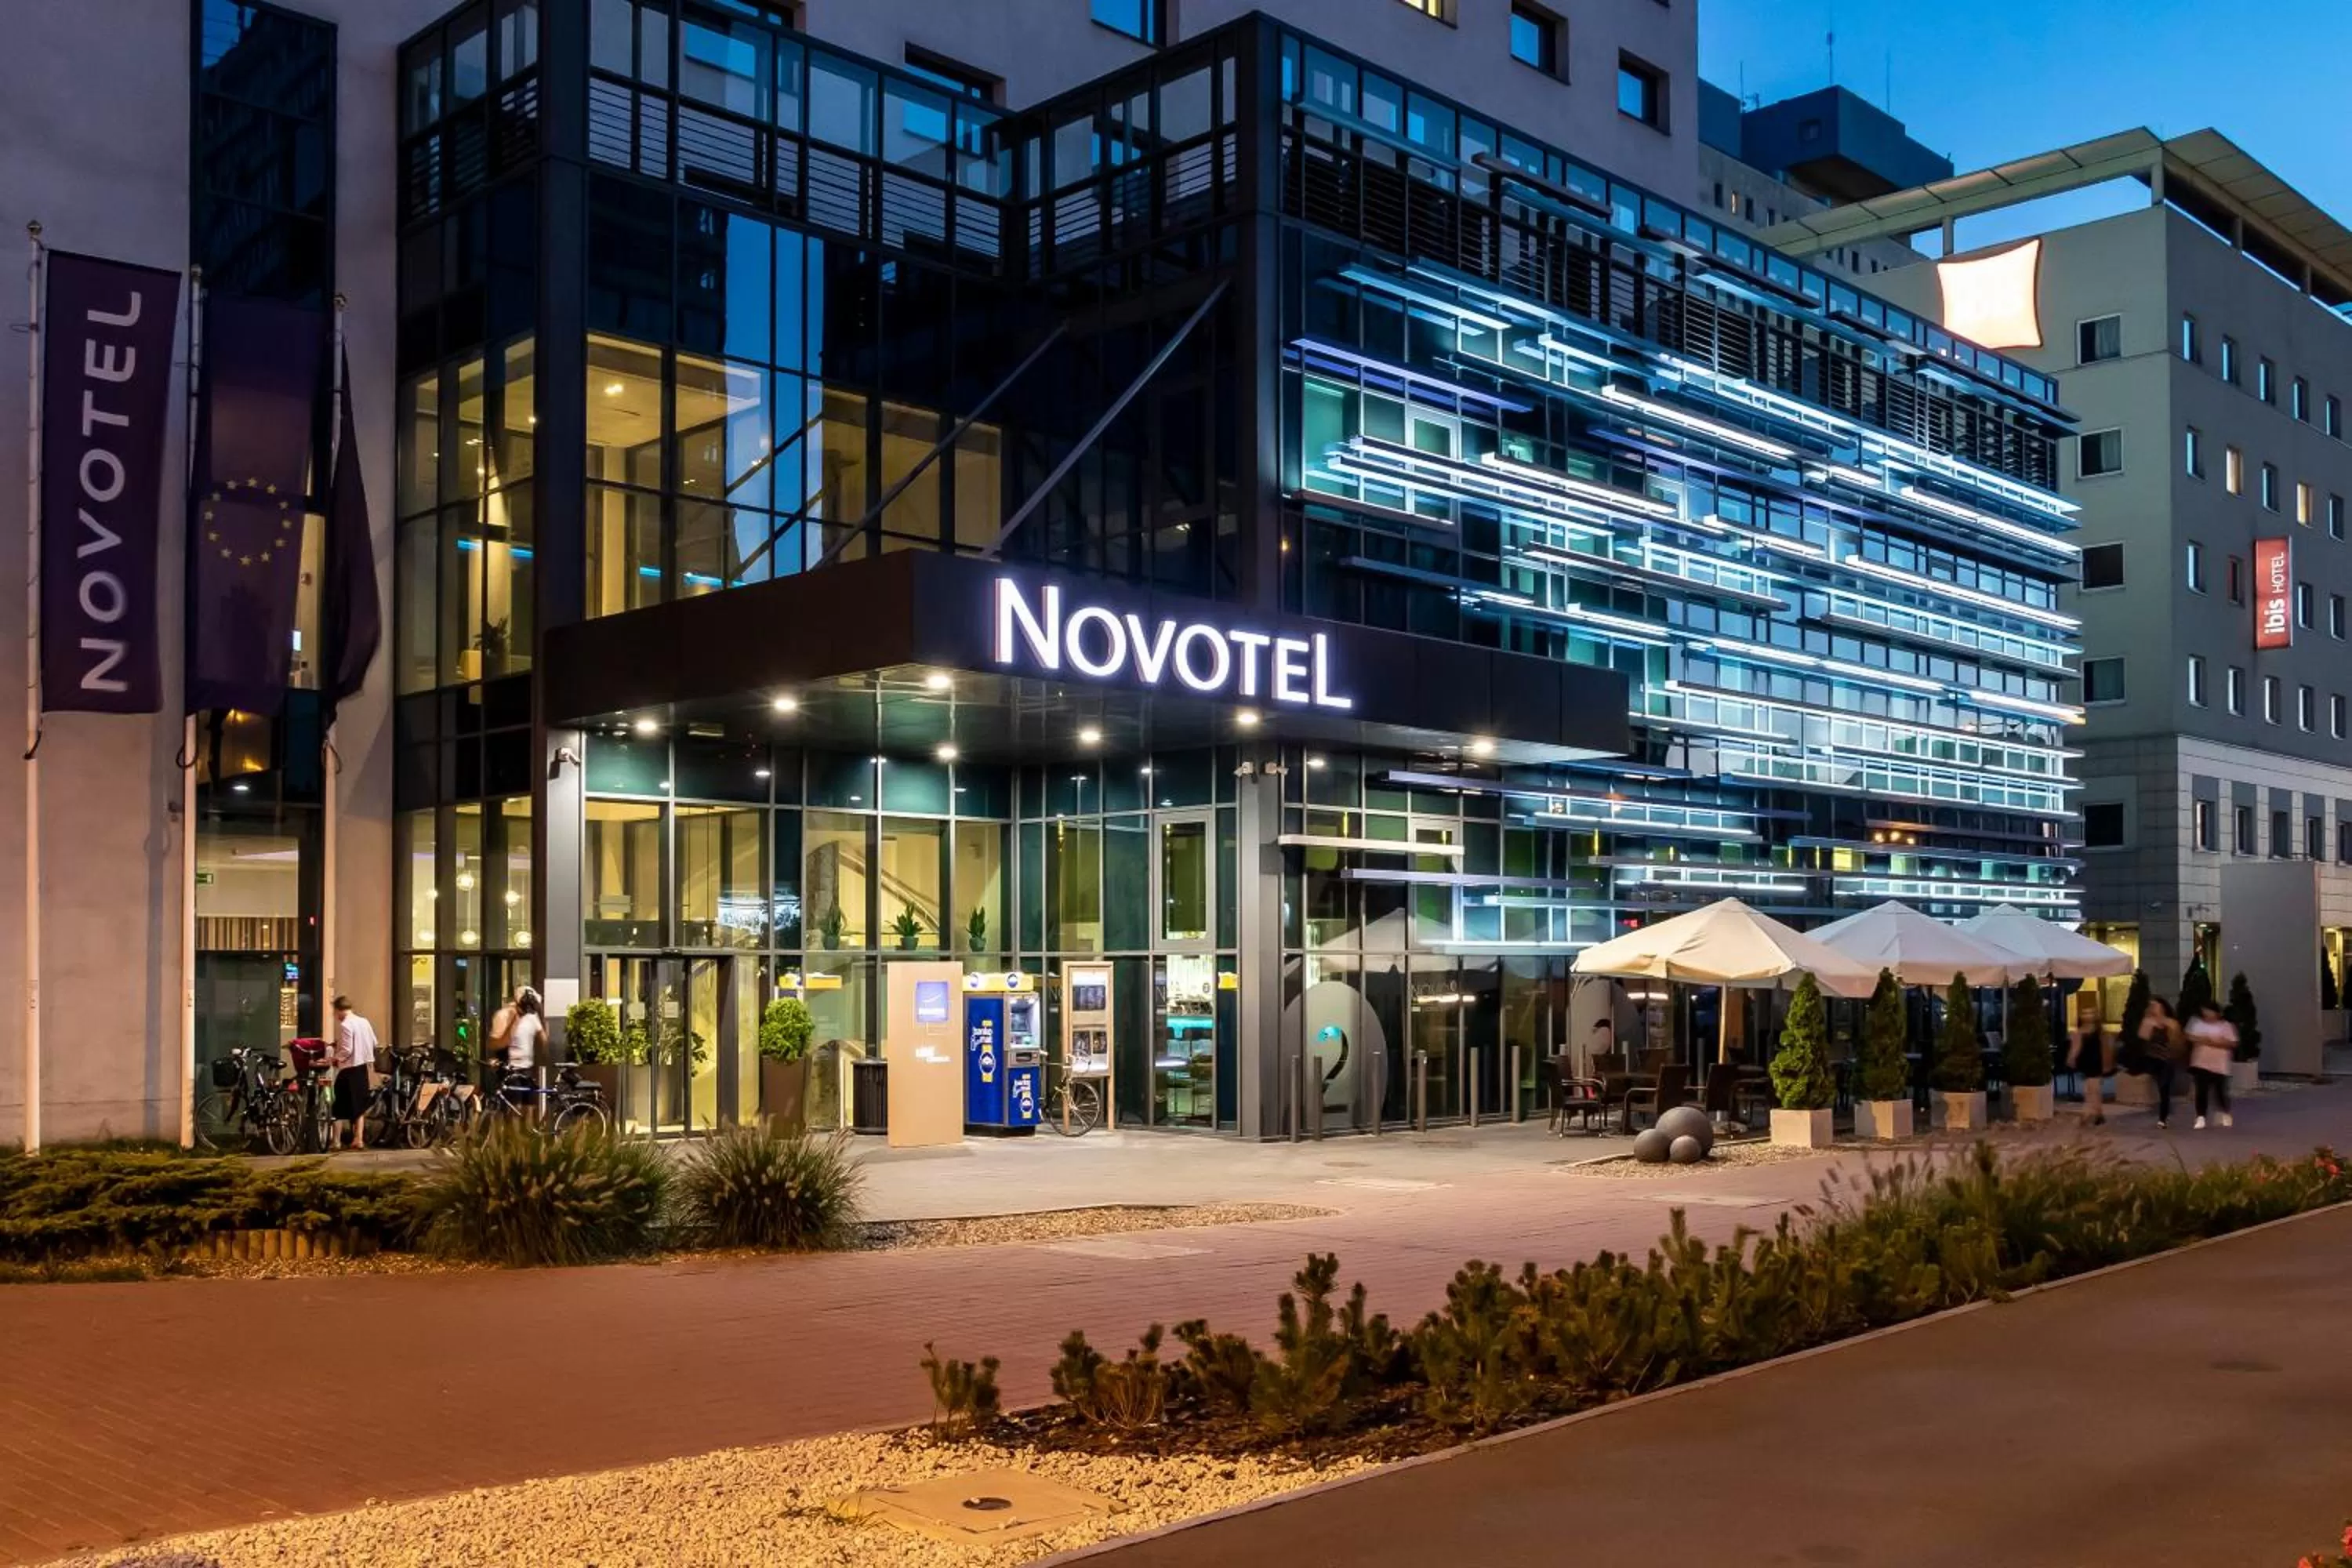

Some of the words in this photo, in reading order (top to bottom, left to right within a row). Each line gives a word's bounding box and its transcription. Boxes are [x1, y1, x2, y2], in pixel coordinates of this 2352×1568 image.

[78, 289, 142, 693] NOVOTEL
[2263, 597, 2286, 634] ibis
[2270, 551, 2285, 593] HOTEL
[994, 577, 1352, 709] NOVOTEL
